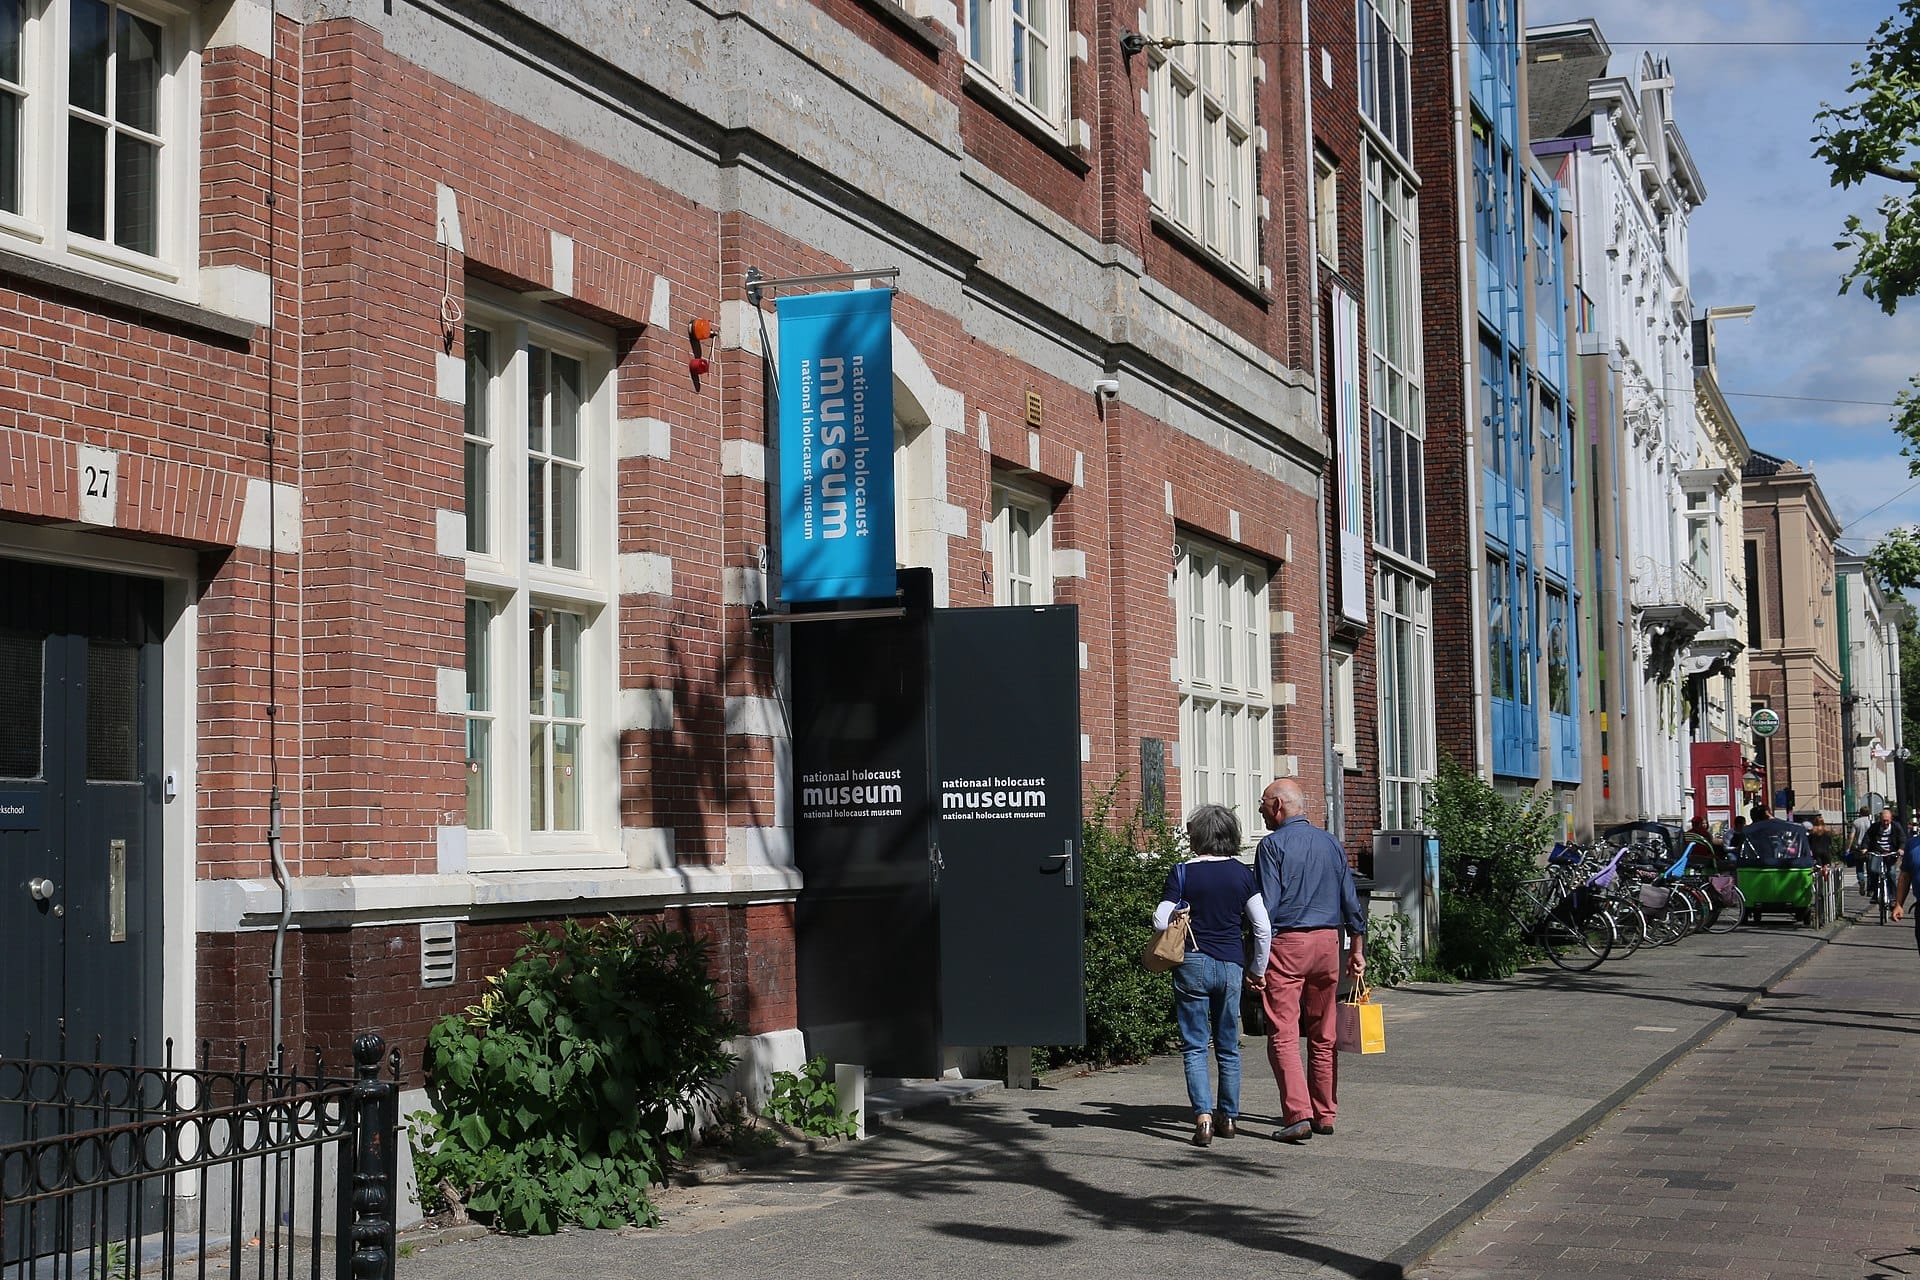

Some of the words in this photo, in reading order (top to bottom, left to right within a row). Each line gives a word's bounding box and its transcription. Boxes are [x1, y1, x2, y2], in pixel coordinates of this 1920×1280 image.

[801, 359, 813, 414] national
[853, 355, 869, 442] nationaal
[802, 417, 814, 481] holocaust
[820, 357, 847, 540] museum
[85, 465, 110, 498] 27
[854, 447, 870, 537] holocaust
[804, 484, 813, 540] museum
[803, 769, 849, 783] nationaal
[852, 769, 902, 781] holocaust
[942, 777, 991, 788] nationaal
[994, 776, 1046, 787] holocaust
[803, 784, 902, 806] museum
[942, 790, 1046, 809] museum
[803, 810, 833, 819] national
[834, 809, 870, 818] holocaust
[870, 809, 902, 817] museum
[942, 811, 974, 820] national
[975, 811, 1012, 820] holocaust
